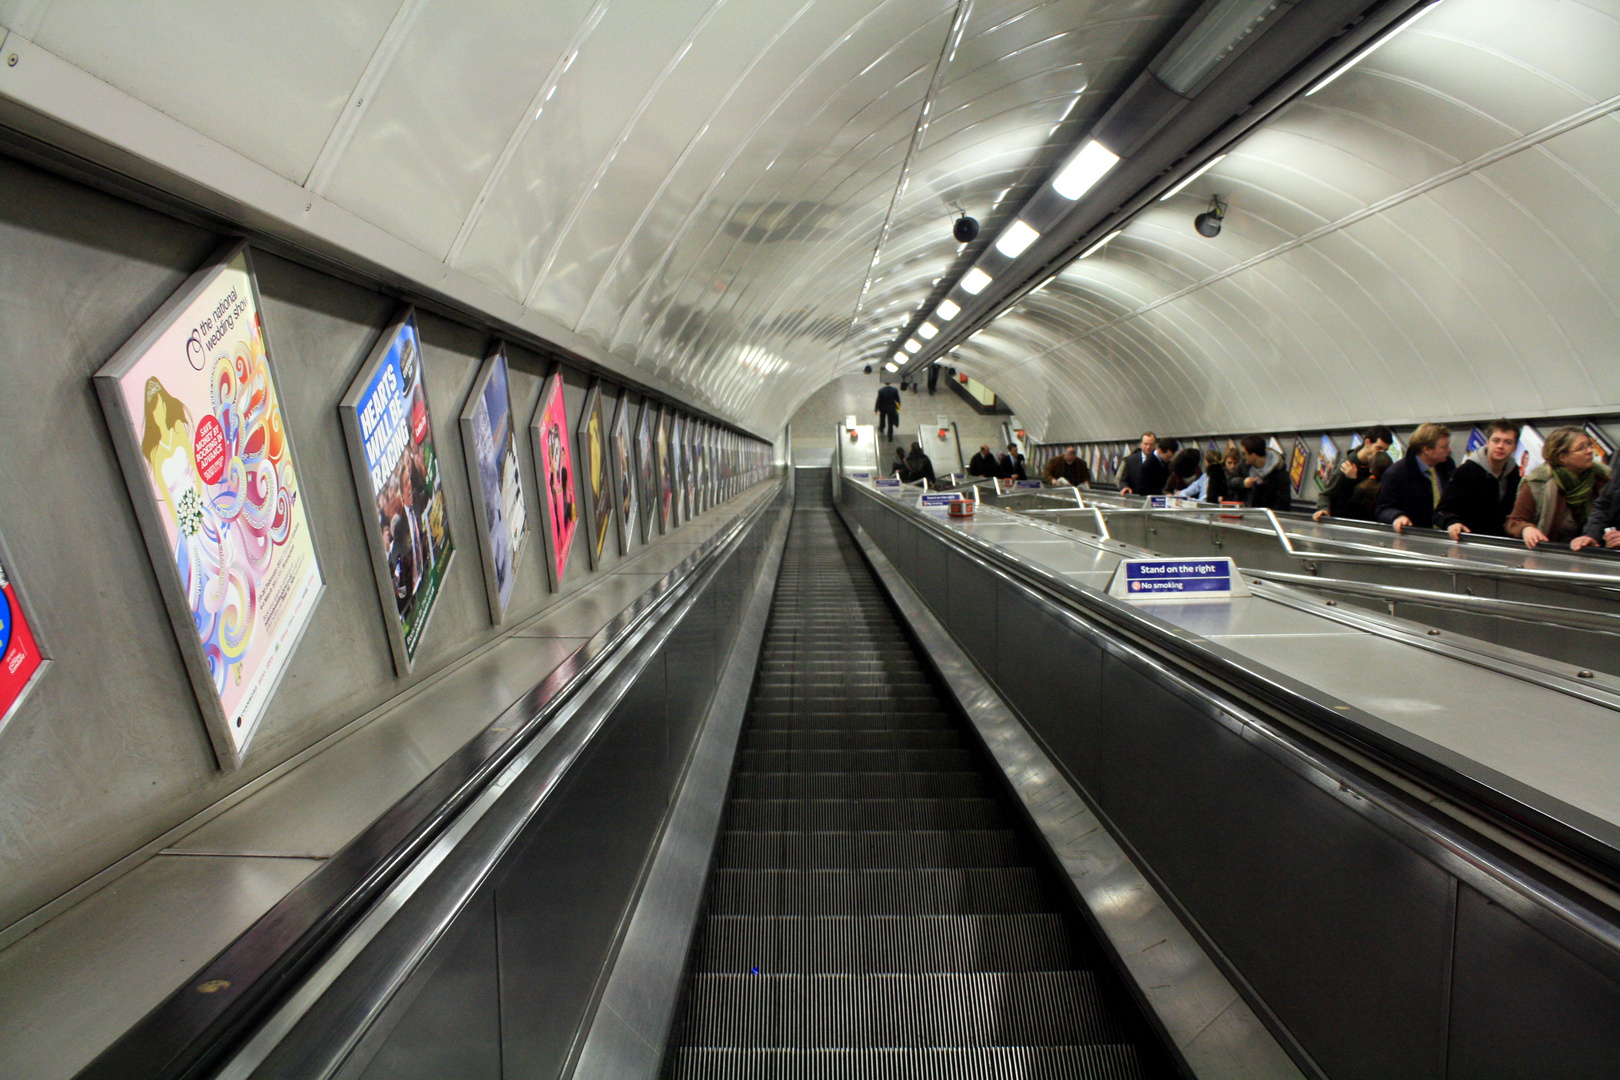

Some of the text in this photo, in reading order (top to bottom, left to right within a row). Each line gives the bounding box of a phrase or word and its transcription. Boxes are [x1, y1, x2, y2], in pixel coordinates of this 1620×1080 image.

[200, 285, 238, 336] the national
[205, 315, 235, 352] wedding
[233, 295, 249, 320] show
[360, 363, 397, 441] HEARTS
[196, 425, 220, 452] MONEY BY
[200, 421, 212, 437] SAVE
[365, 389, 404, 467] WILL BE
[196, 432, 224, 462] BOOKING IN
[201, 443, 223, 470] ADVANCE
[371, 417, 410, 496] RACING
[1140, 565, 1165, 574] Stand
[1179, 564, 1194, 573] the
[1195, 564, 1216, 575] right
[1141, 581, 1183, 590] No smoking
